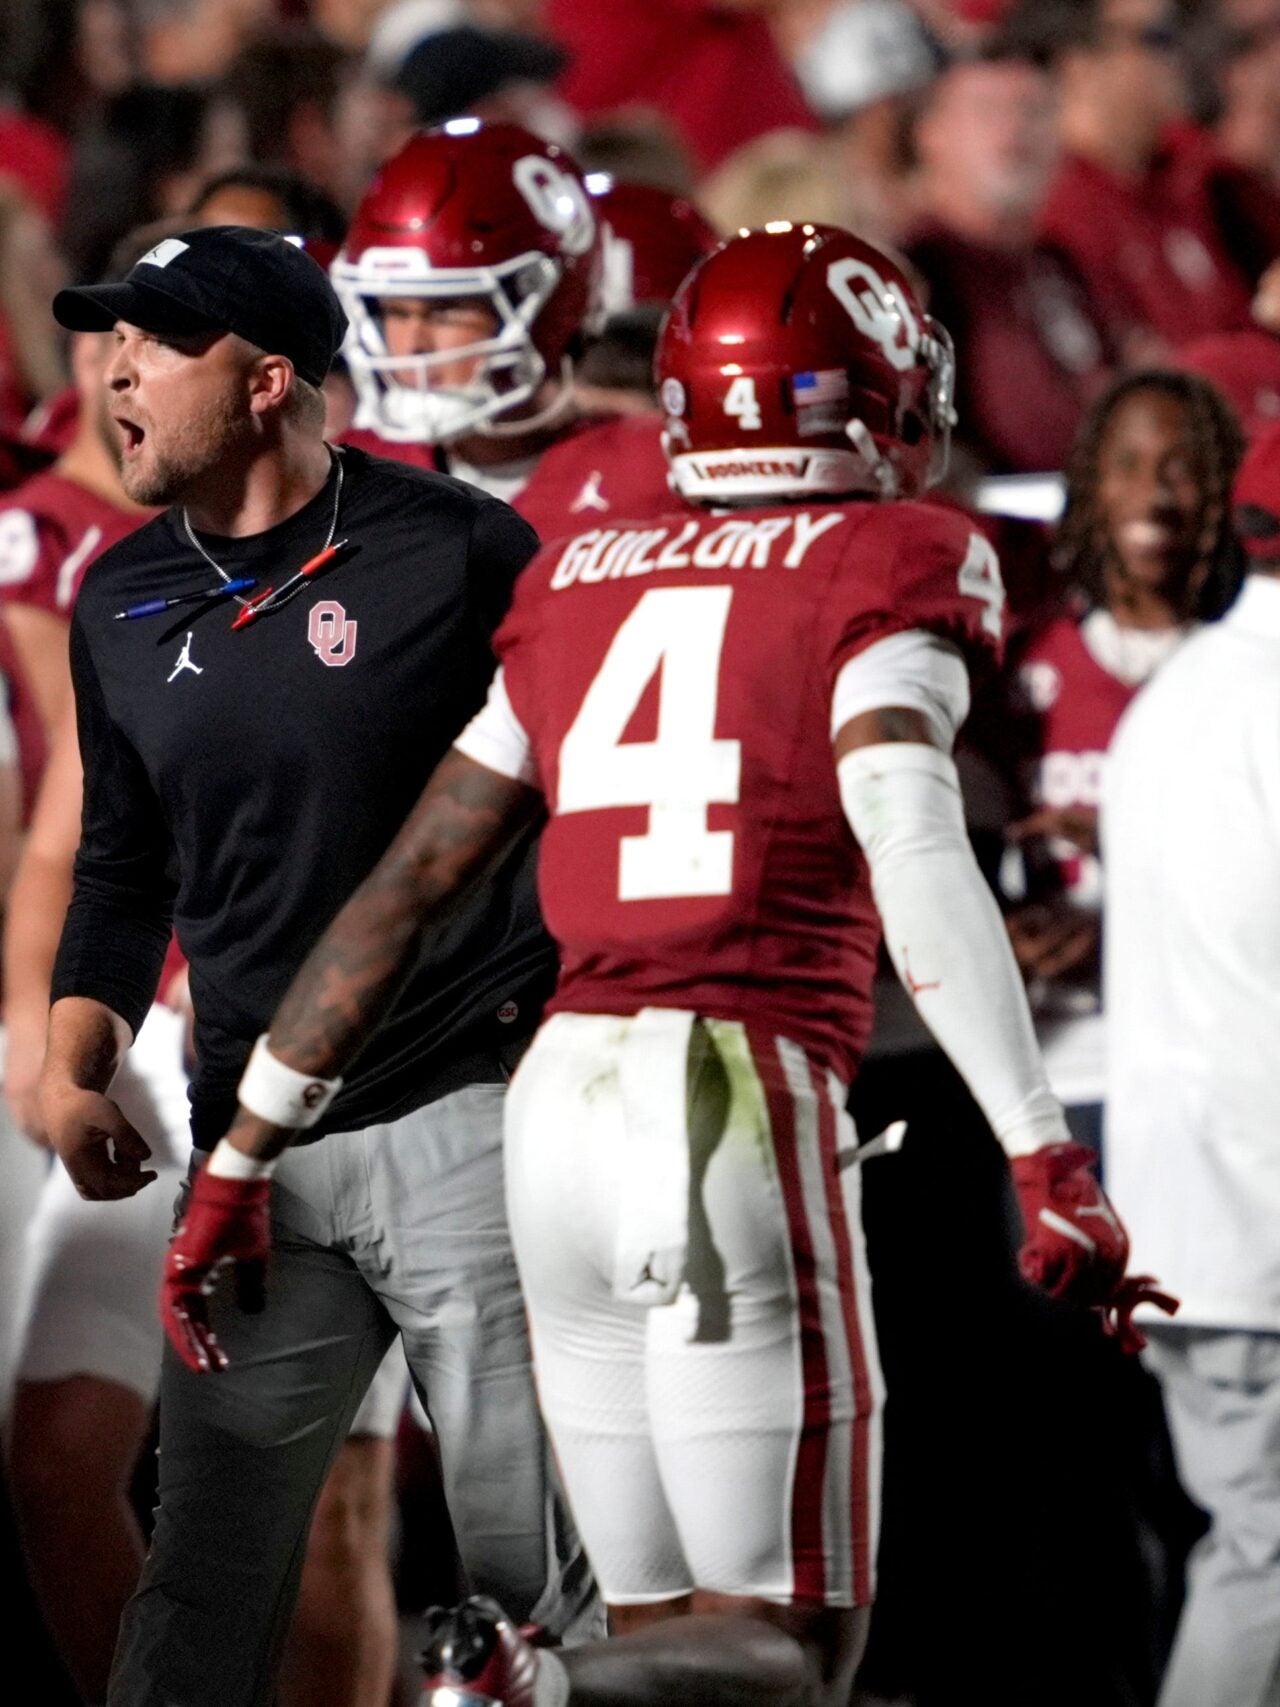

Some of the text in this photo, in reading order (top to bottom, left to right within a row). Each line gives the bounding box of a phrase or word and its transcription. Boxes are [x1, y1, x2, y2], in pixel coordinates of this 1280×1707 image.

[827, 256, 919, 371] OU
[723, 377, 763, 431] 4
[549, 513, 845, 591] GUILLORY
[958, 532, 1006, 642] 4
[307, 600, 358, 667] OU
[555, 584, 742, 902] 4
